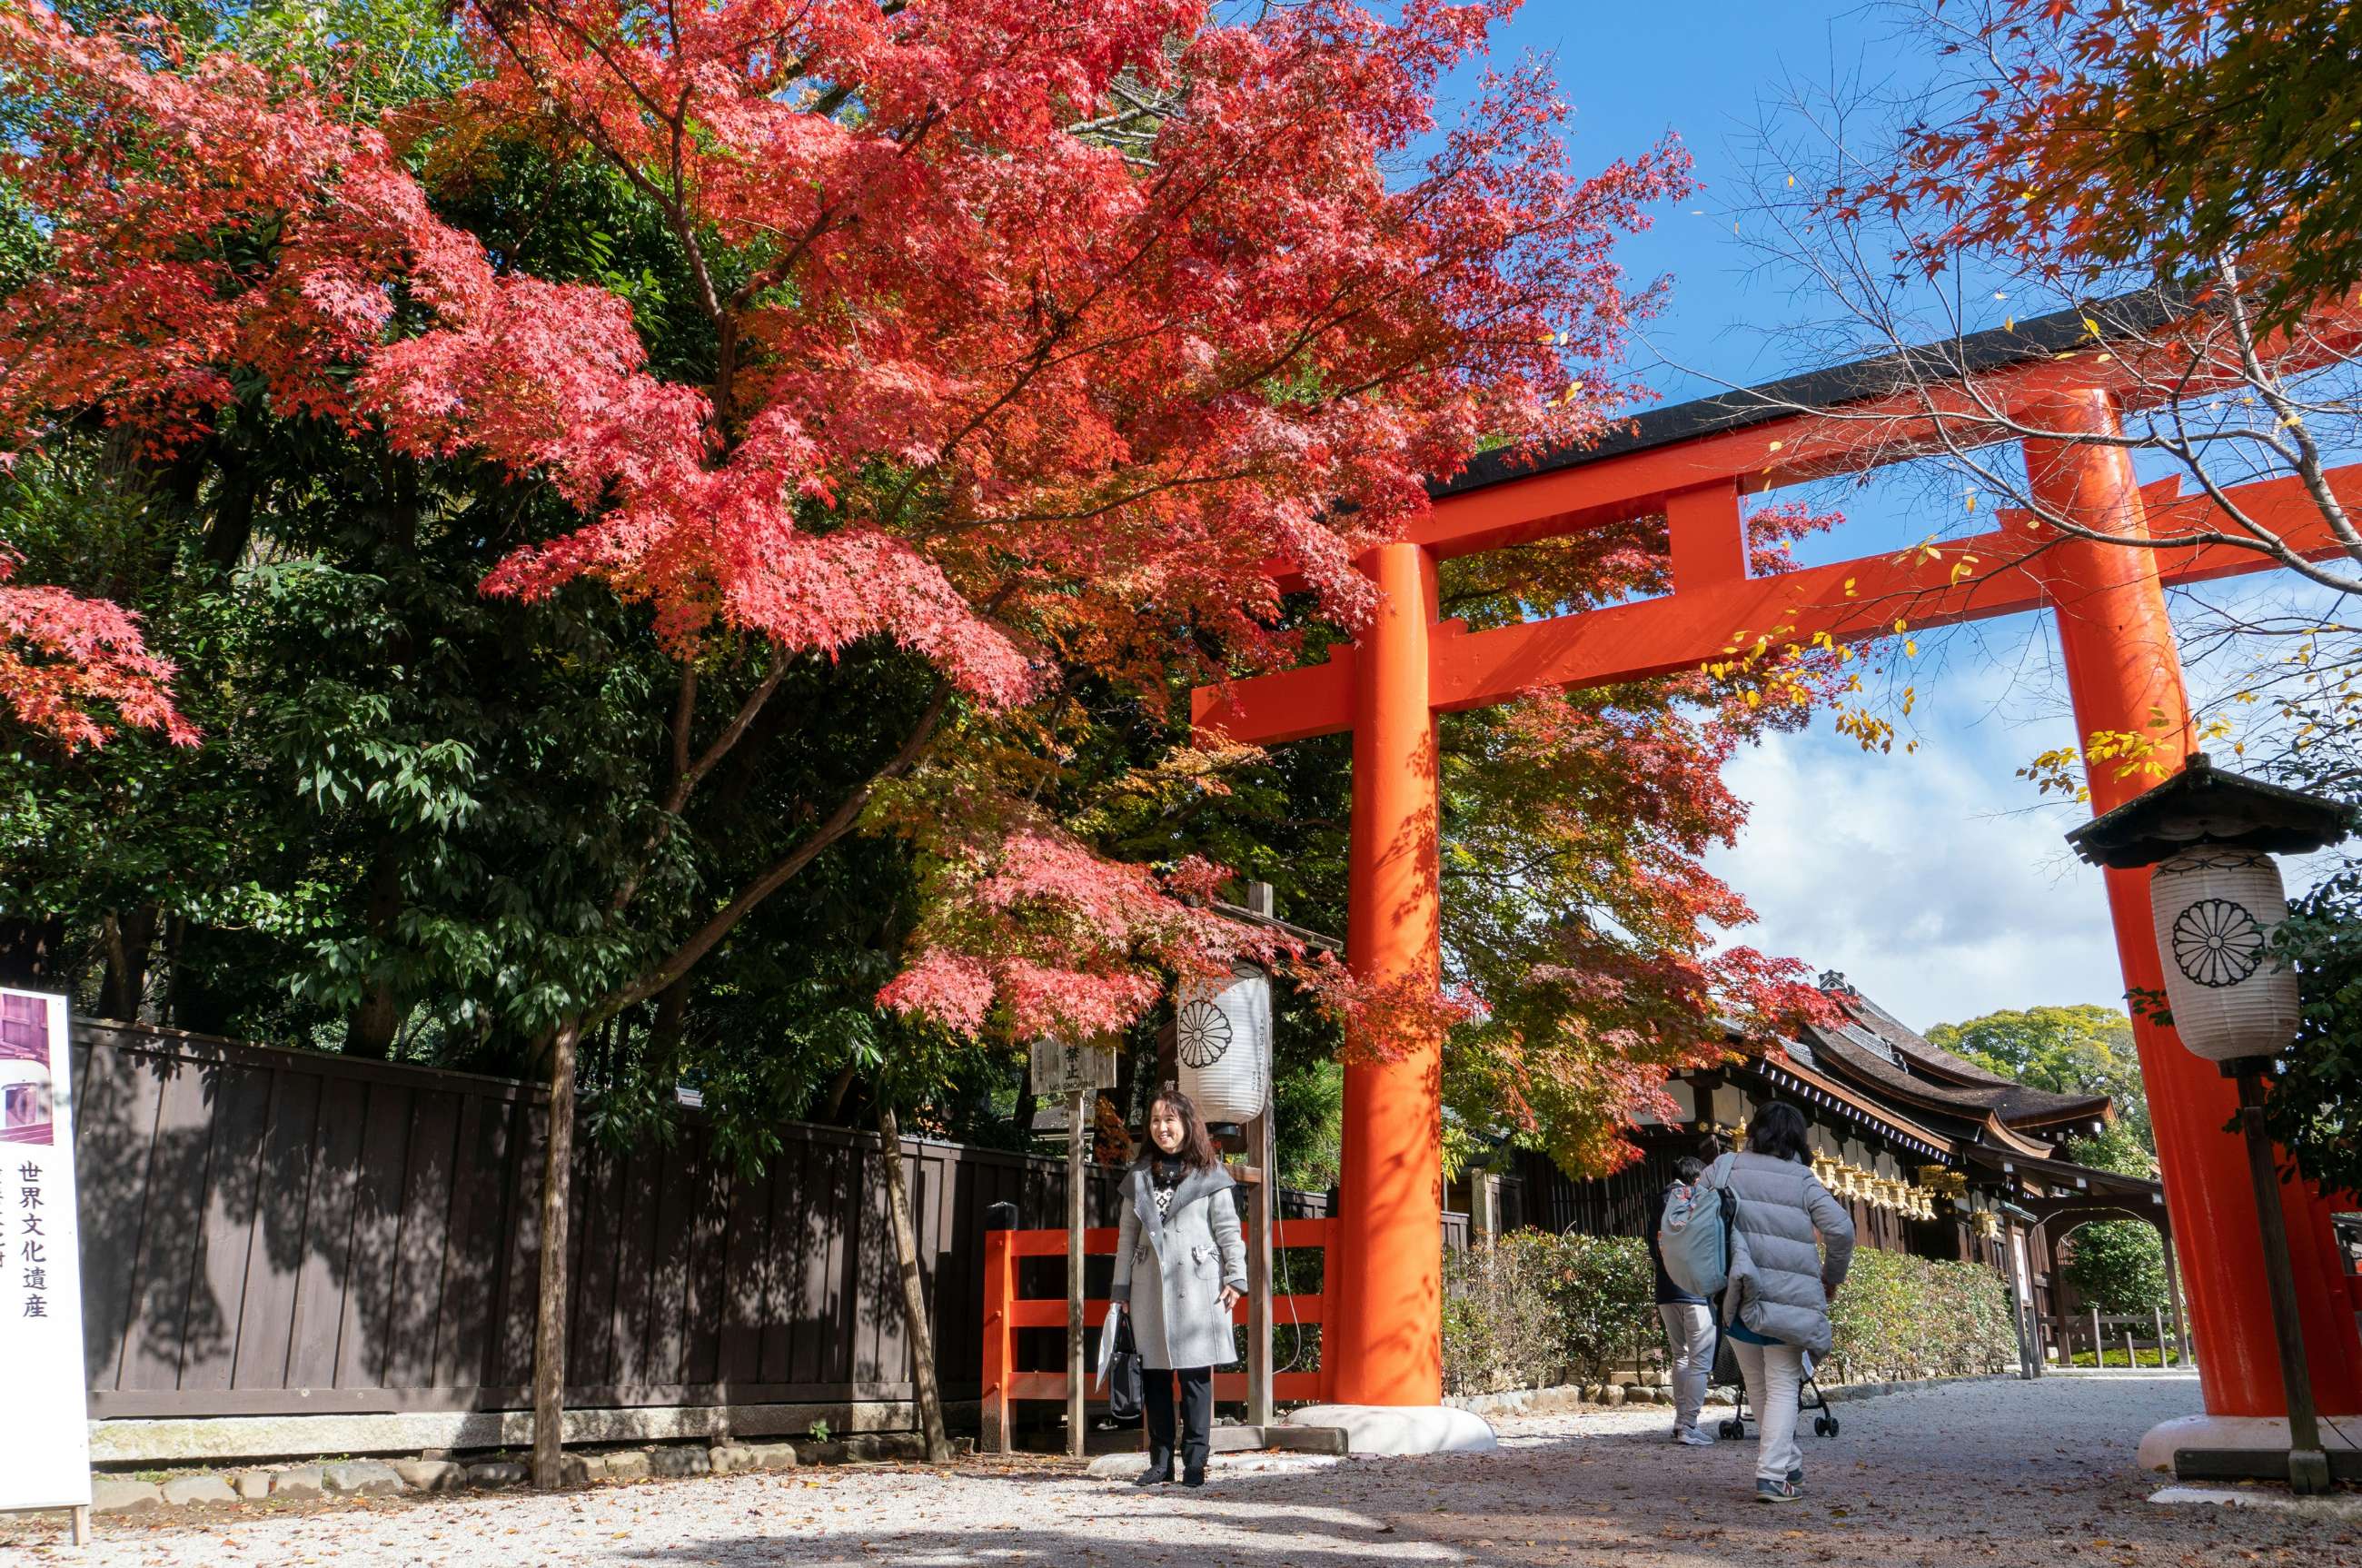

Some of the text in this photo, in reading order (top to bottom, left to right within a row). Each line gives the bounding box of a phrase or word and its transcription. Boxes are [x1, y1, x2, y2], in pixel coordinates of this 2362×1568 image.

[1062, 1080, 1097, 1090] SMOKING
[17, 1159, 48, 1318] 世界文化遺産
